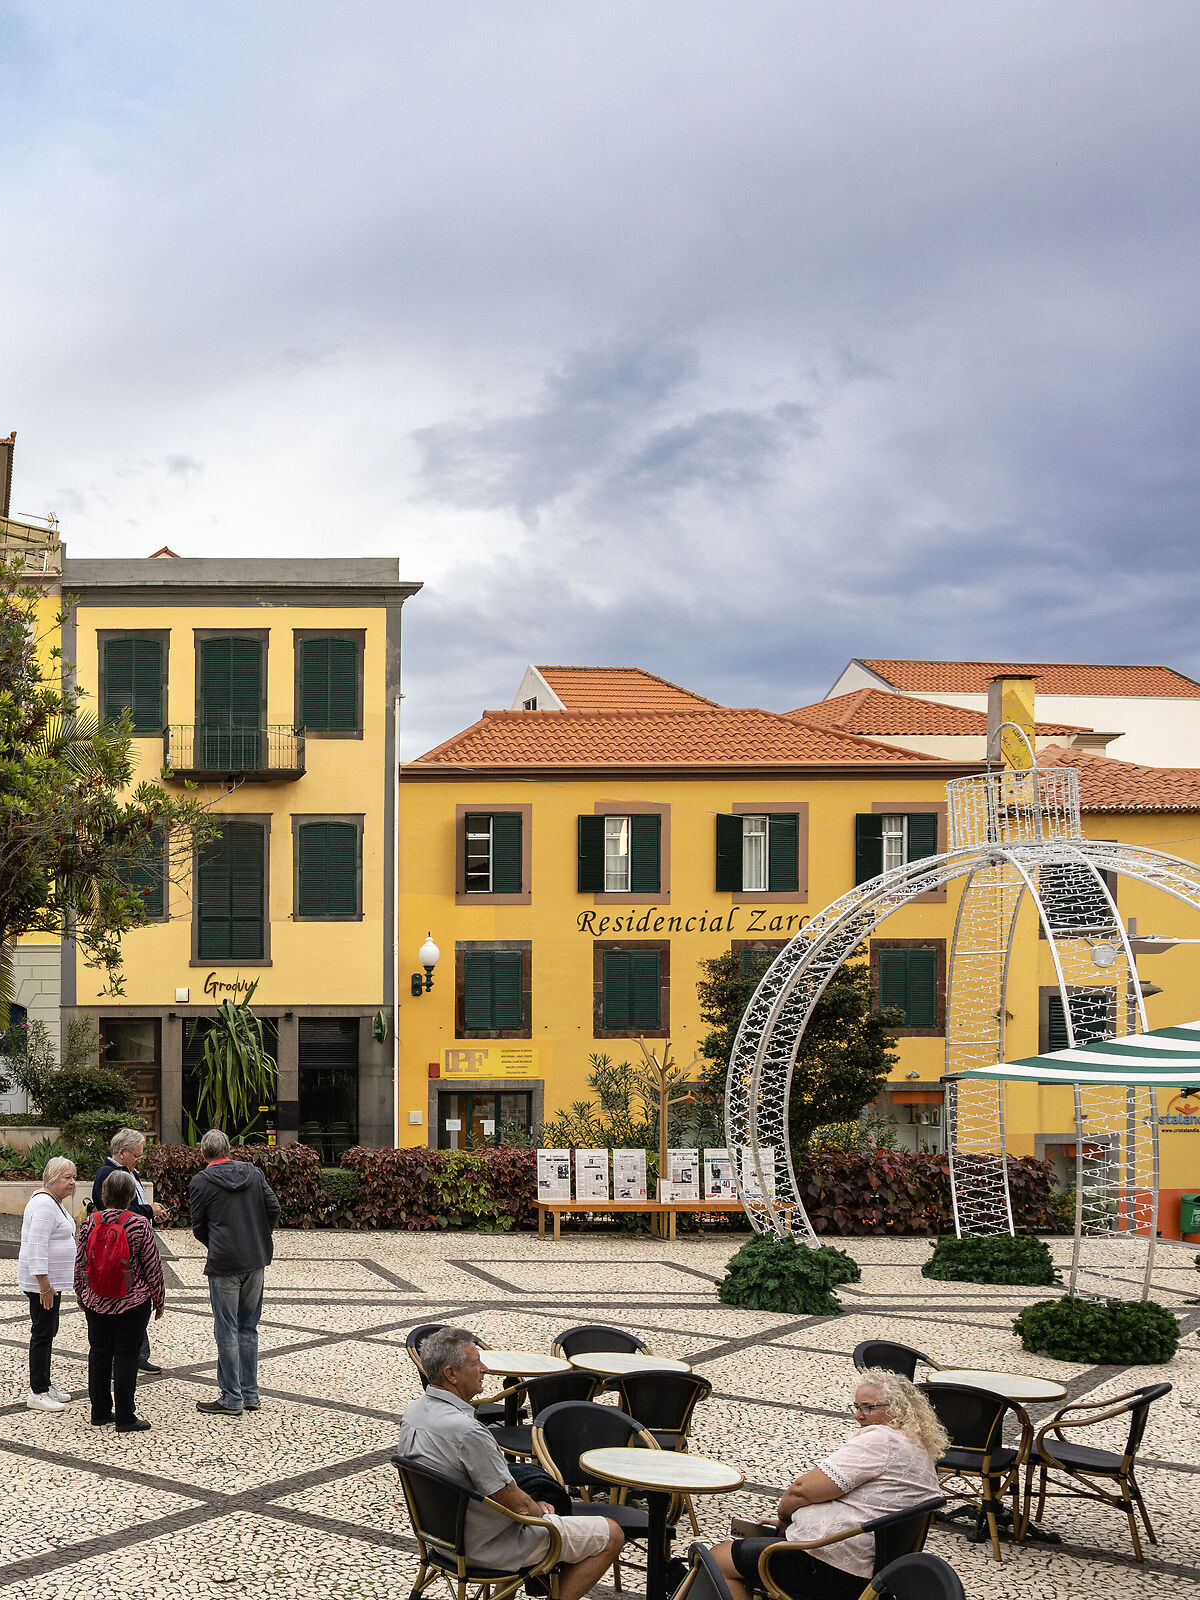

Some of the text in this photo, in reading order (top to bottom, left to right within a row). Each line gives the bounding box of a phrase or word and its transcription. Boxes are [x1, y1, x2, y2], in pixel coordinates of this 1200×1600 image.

[576, 907, 812, 936] Residencial Zarc
[1143, 1113, 1200, 1125] cstalan
